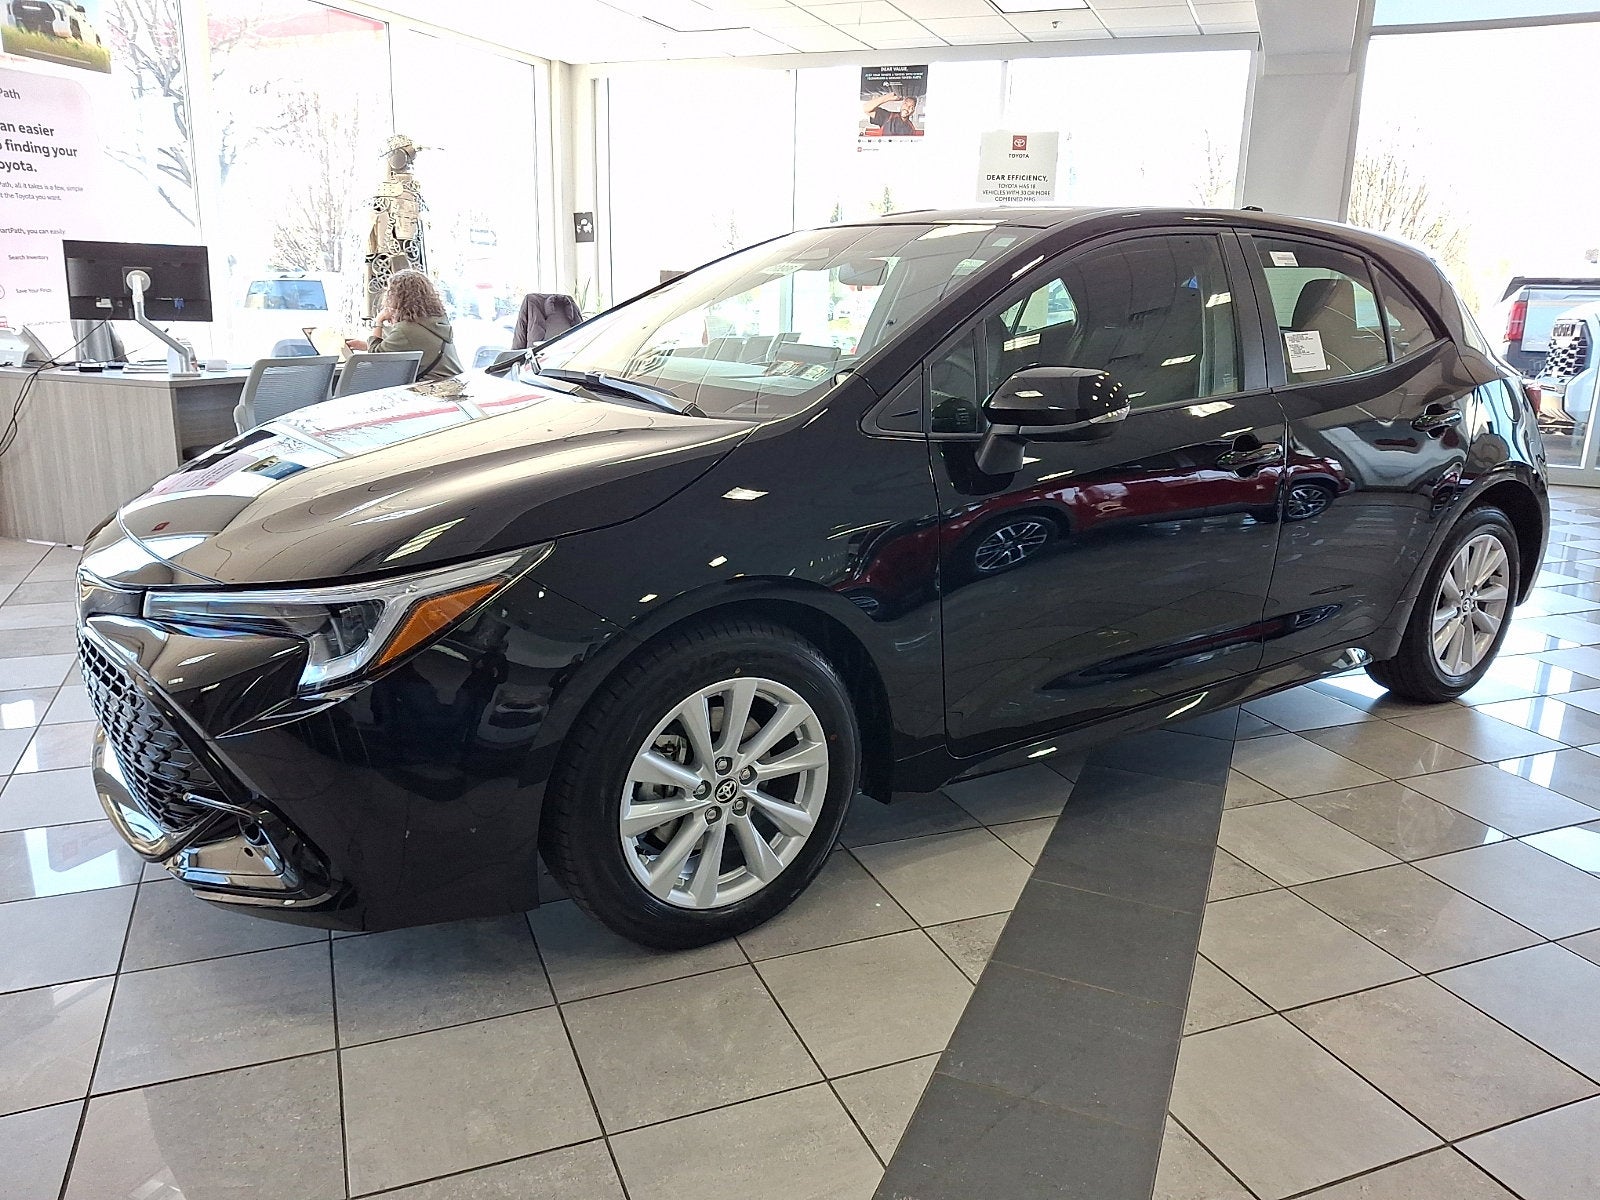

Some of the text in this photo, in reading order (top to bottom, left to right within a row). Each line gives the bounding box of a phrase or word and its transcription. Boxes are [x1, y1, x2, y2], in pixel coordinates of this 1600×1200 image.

[18, 124, 54, 136] easier
[5, 139, 50, 157] finding
[51, 147, 77, 158] your
[1007, 174, 1049, 182] EFFICIENCY,
[15, 192, 36, 201] Toyota
